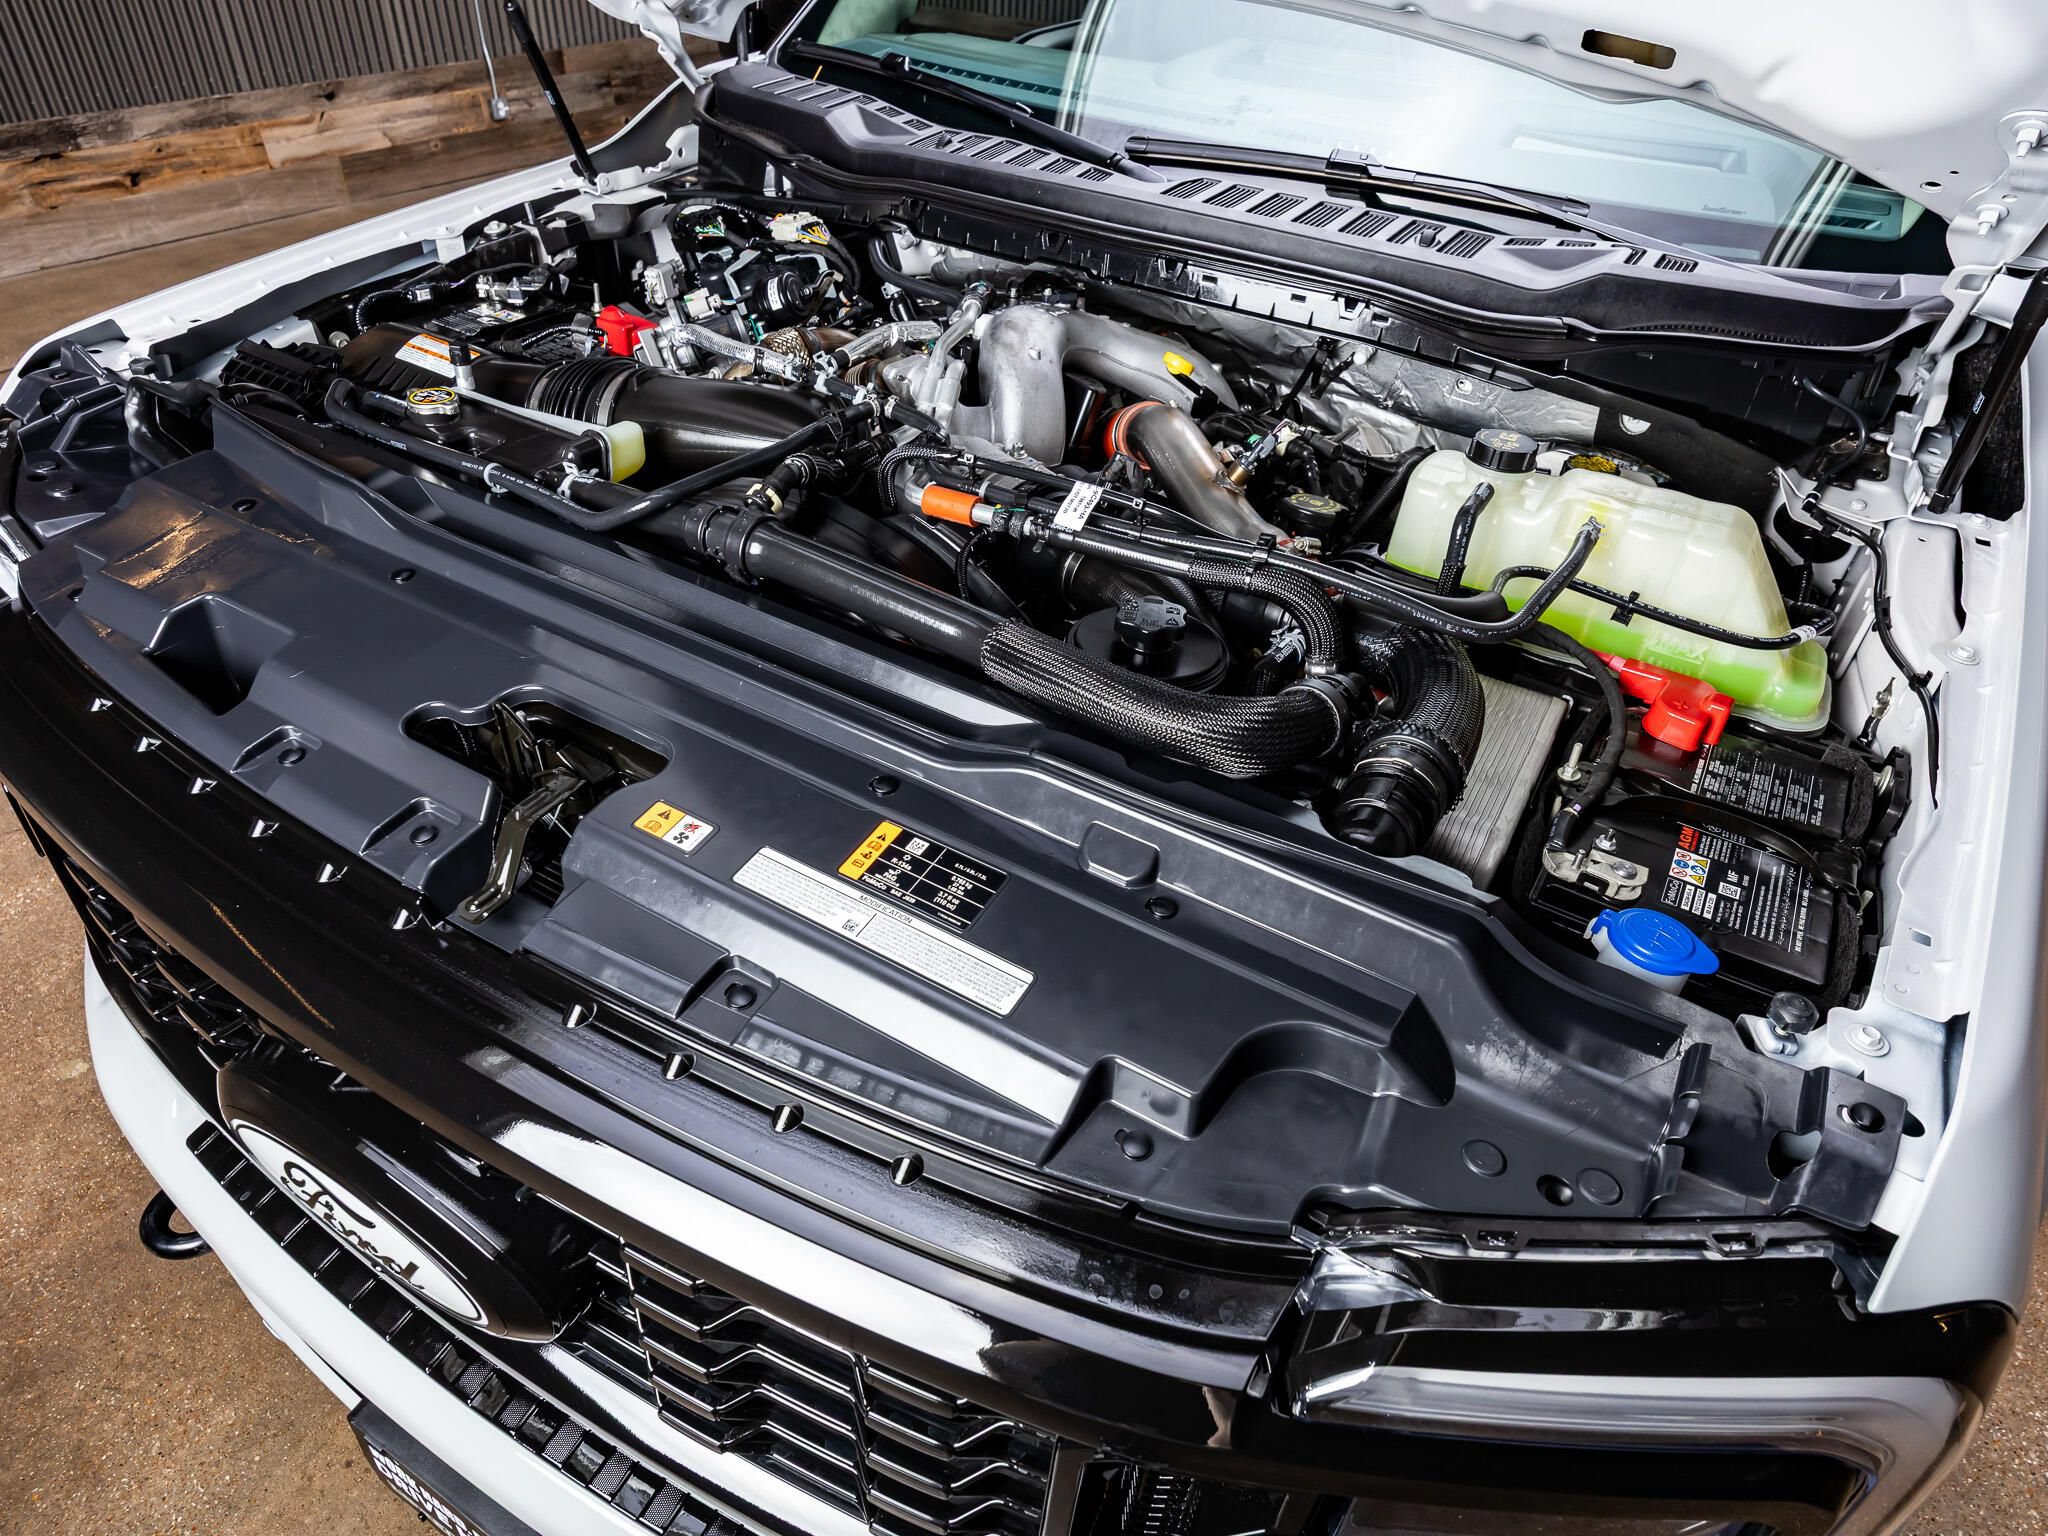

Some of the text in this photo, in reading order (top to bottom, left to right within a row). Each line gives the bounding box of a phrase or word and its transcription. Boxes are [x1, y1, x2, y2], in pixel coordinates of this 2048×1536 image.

[1678, 827, 1694, 849] AGM
[891, 858, 912, 871] R-134a
[862, 875, 887, 890] FoMoCo
[1664, 879, 1681, 905] FoMoCo
[858, 894, 913, 924] MODIFICATION
[280, 1161, 425, 1290] Ford
[373, 1457, 453, 1530] DRIVE
